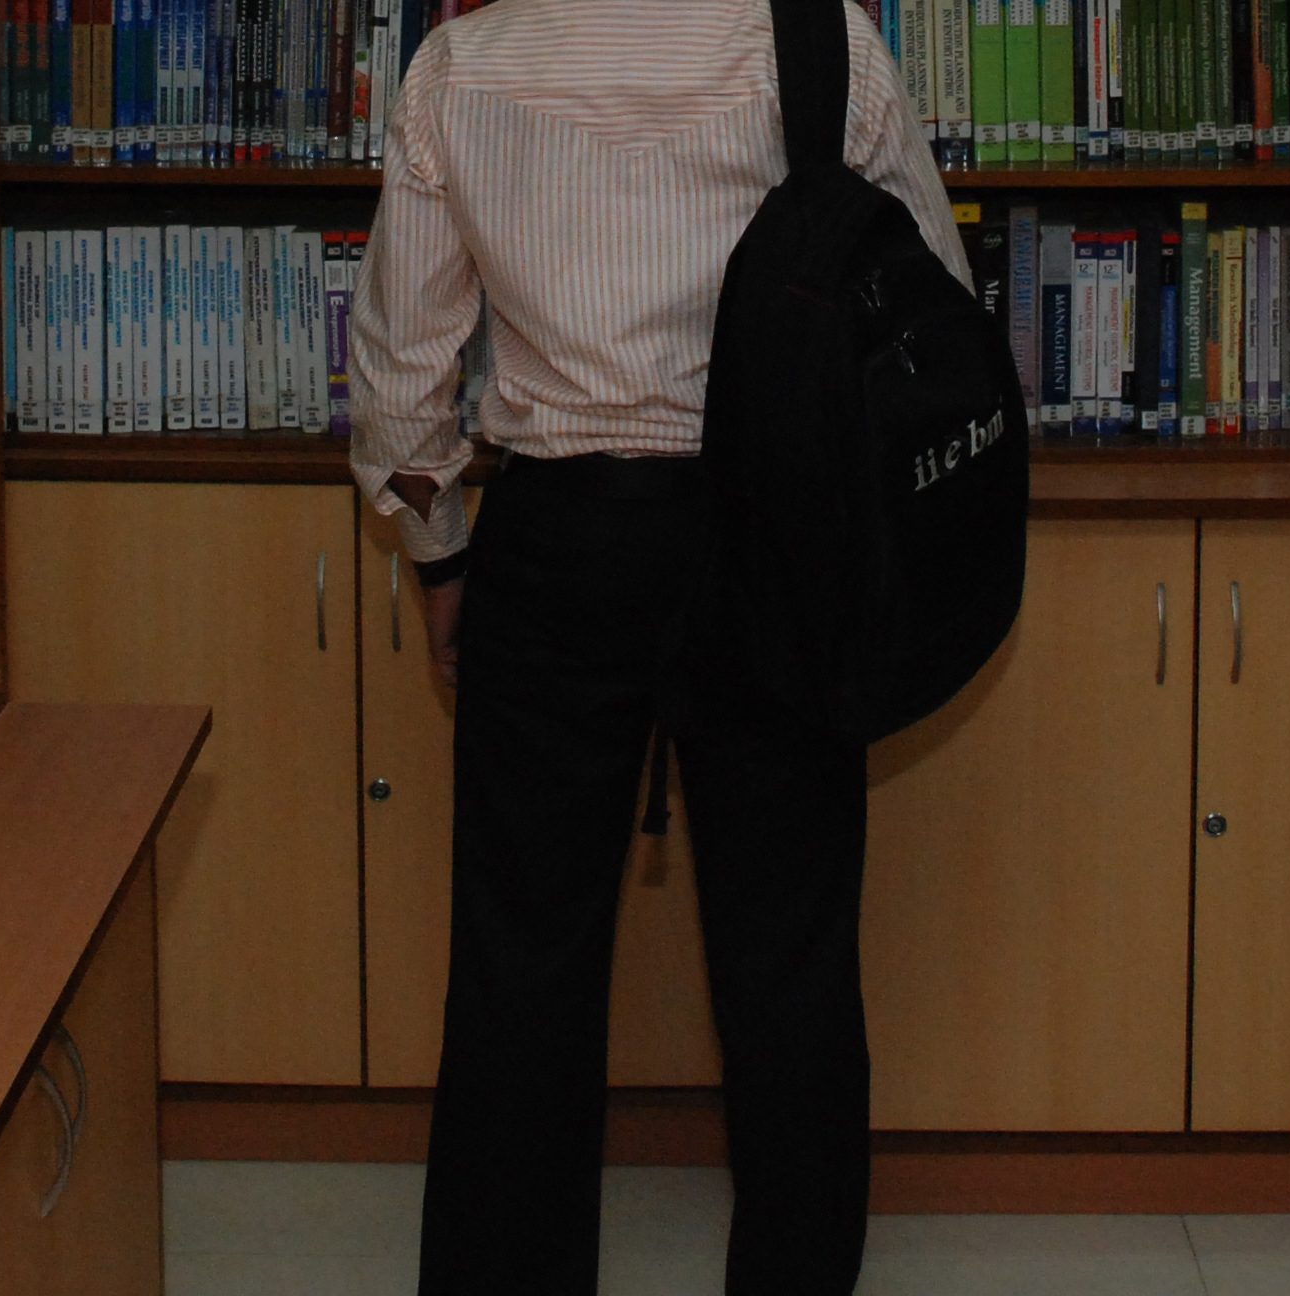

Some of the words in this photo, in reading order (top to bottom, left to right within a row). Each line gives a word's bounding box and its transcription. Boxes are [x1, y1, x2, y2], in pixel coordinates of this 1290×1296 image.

[158, 13, 170, 71] DEVELOPMENT
[175, 14, 187, 71] DEVELOPMENT
[192, 12, 203, 70] DEVELOPMENT
[943, 9, 954, 57] INVENTORY
[915, 48, 926, 94] PLANNING
[943, 59, 954, 99] CONTROL
[954, 48, 964, 94] PLANNING
[915, 95, 926, 116] AND
[954, 95, 964, 115] AND
[1227, 262, 1238, 301] Research
[1083, 285, 1094, 329] MANAGEMENT
[1109, 286, 1120, 330] MANAGEMENT
[1186, 266, 1204, 379] Management
[330, 295, 344, 368] Entrepreneurship
[1053, 292, 1066, 392] MANAGEMENT
[1083, 331, 1094, 361] CONTROL
[1109, 332, 1120, 362] CONTROL
[1226, 304, 1239, 360] Methodology
[1083, 362, 1094, 392] SYSTEMS
[1108, 363, 1120, 393] SYSTEMS
[913, 410, 1005, 492] iiebm
